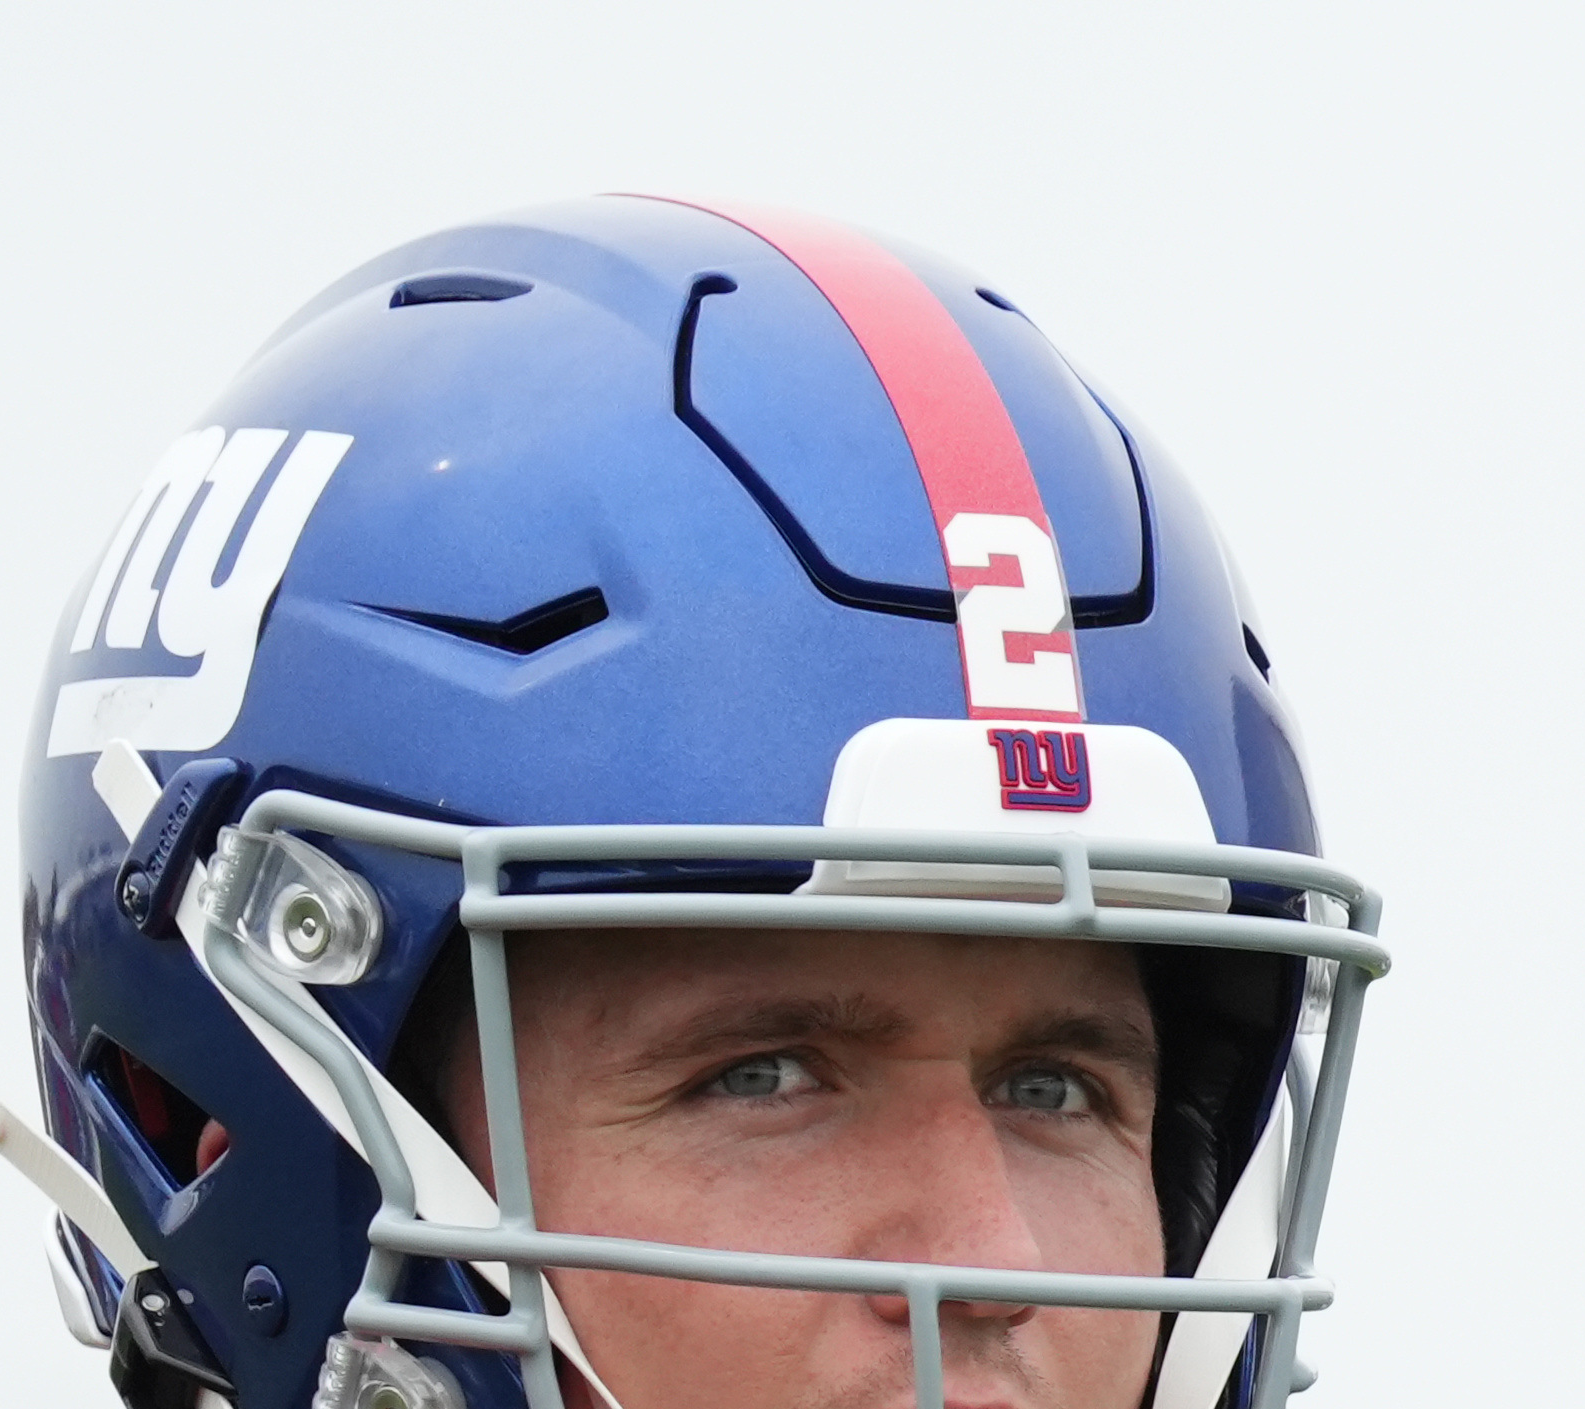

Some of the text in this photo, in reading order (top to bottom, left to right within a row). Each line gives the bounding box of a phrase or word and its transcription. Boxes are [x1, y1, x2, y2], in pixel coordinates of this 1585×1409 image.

[46, 425, 355, 758] ny
[943, 512, 1079, 712] 2
[987, 728, 1092, 812] ny
